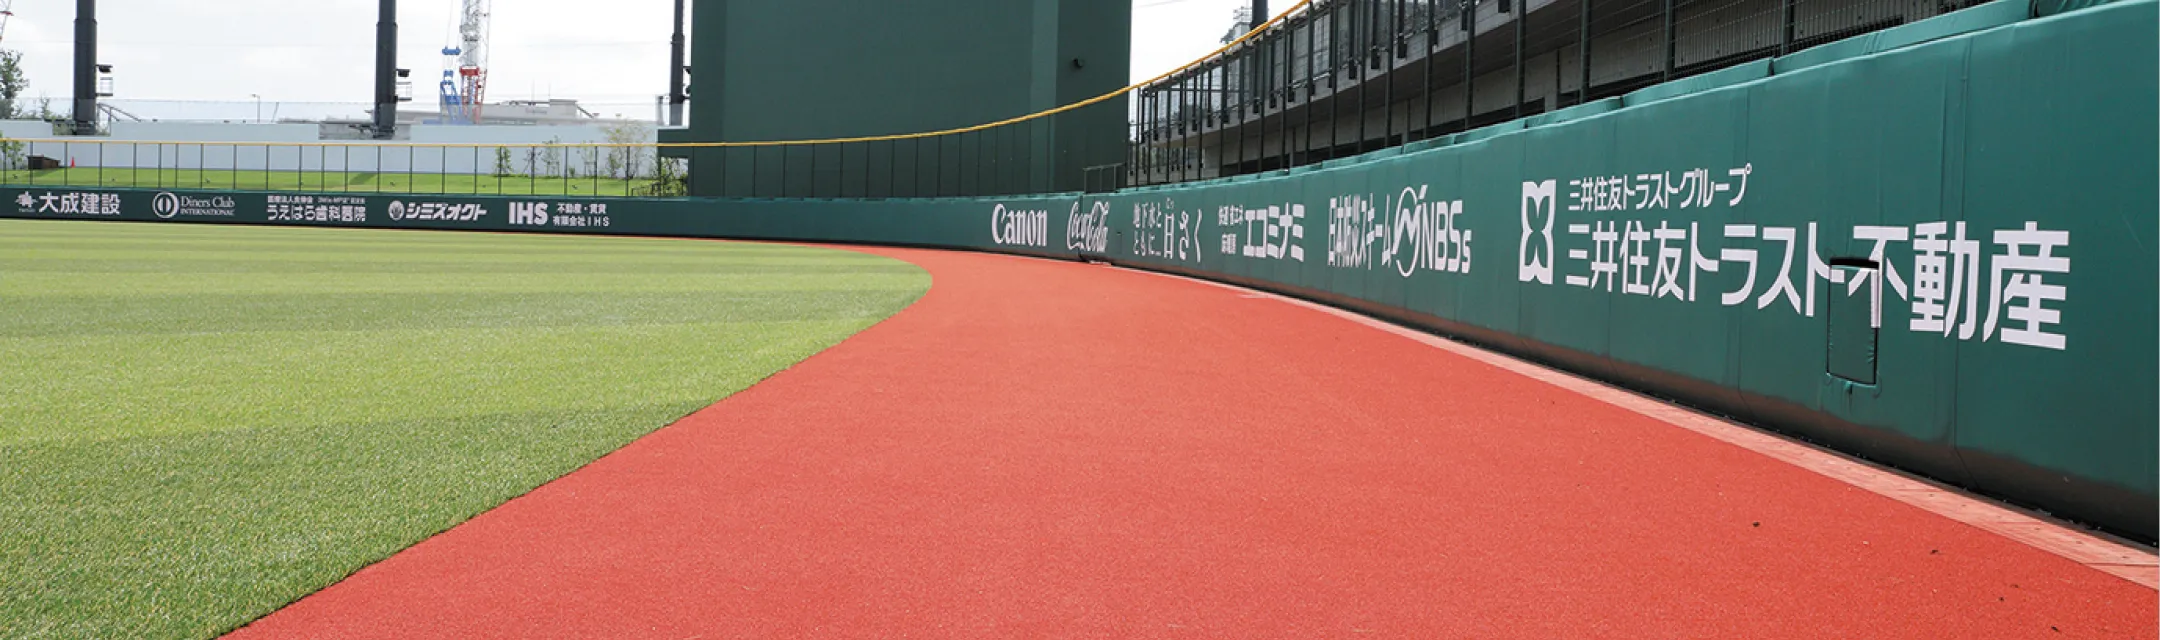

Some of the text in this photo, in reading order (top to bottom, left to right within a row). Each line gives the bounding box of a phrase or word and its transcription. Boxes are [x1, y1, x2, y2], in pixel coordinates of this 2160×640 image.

[39, 191, 121, 215] 大成建設
[181, 195, 236, 208] Diners Club
[1567, 162, 1753, 212] 三井住友トラストグループ
[267, 204, 366, 222] うえはら歯科医院
[405, 202, 488, 221] シミズオクト
[508, 202, 549, 226] IHS
[991, 203, 1048, 247] Canon
[1163, 208, 1203, 263] 日さく
[1243, 202, 1305, 263] エコミナミ
[1565, 219, 2070, 350] 三井住友トラスト不動産
